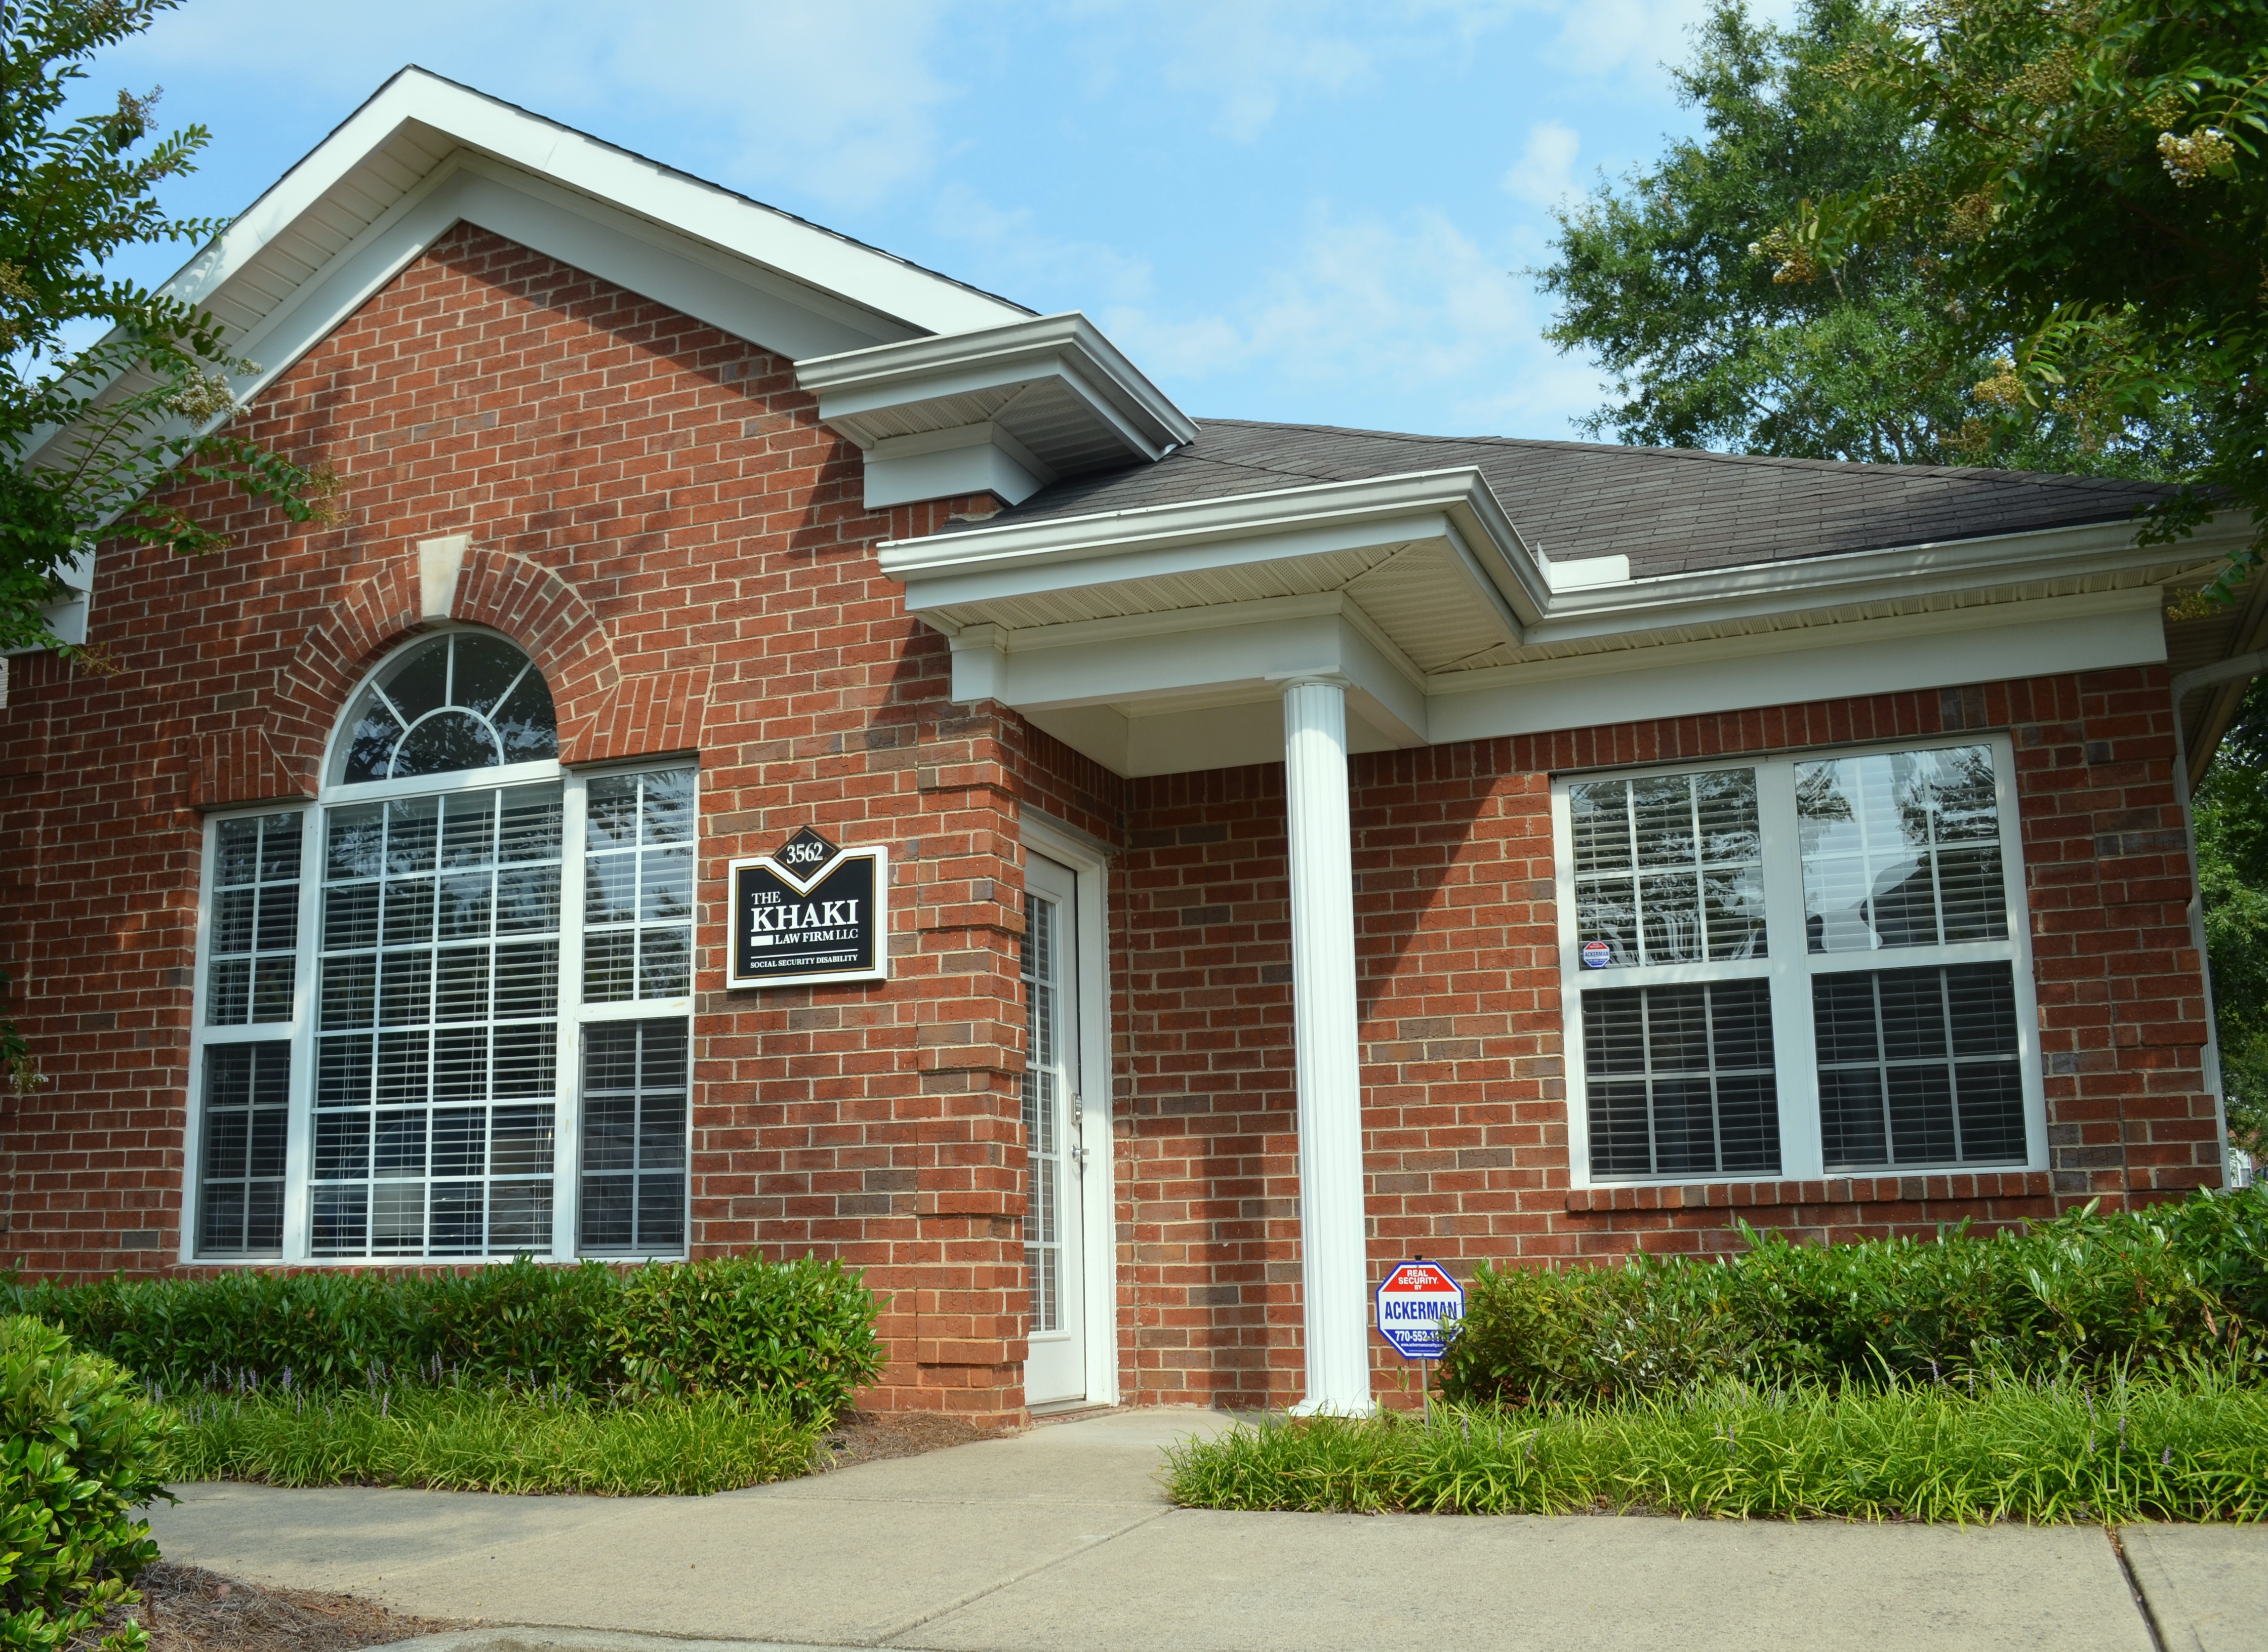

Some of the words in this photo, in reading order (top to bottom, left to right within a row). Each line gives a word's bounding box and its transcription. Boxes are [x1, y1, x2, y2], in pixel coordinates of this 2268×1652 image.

[786, 842, 823, 864] 3562
[751, 891, 781, 905] THE
[750, 899, 859, 932] KHAKI
[775, 934, 800, 945] LAW
[802, 931, 834, 942] FIRM
[836, 929, 858, 940] LLC
[750, 960, 777, 968] SOCIAL
[778, 958, 815, 967] SECURITY
[816, 954, 858, 964] DISABILITY
[1385, 1301, 1457, 1319] ACKERMAN
